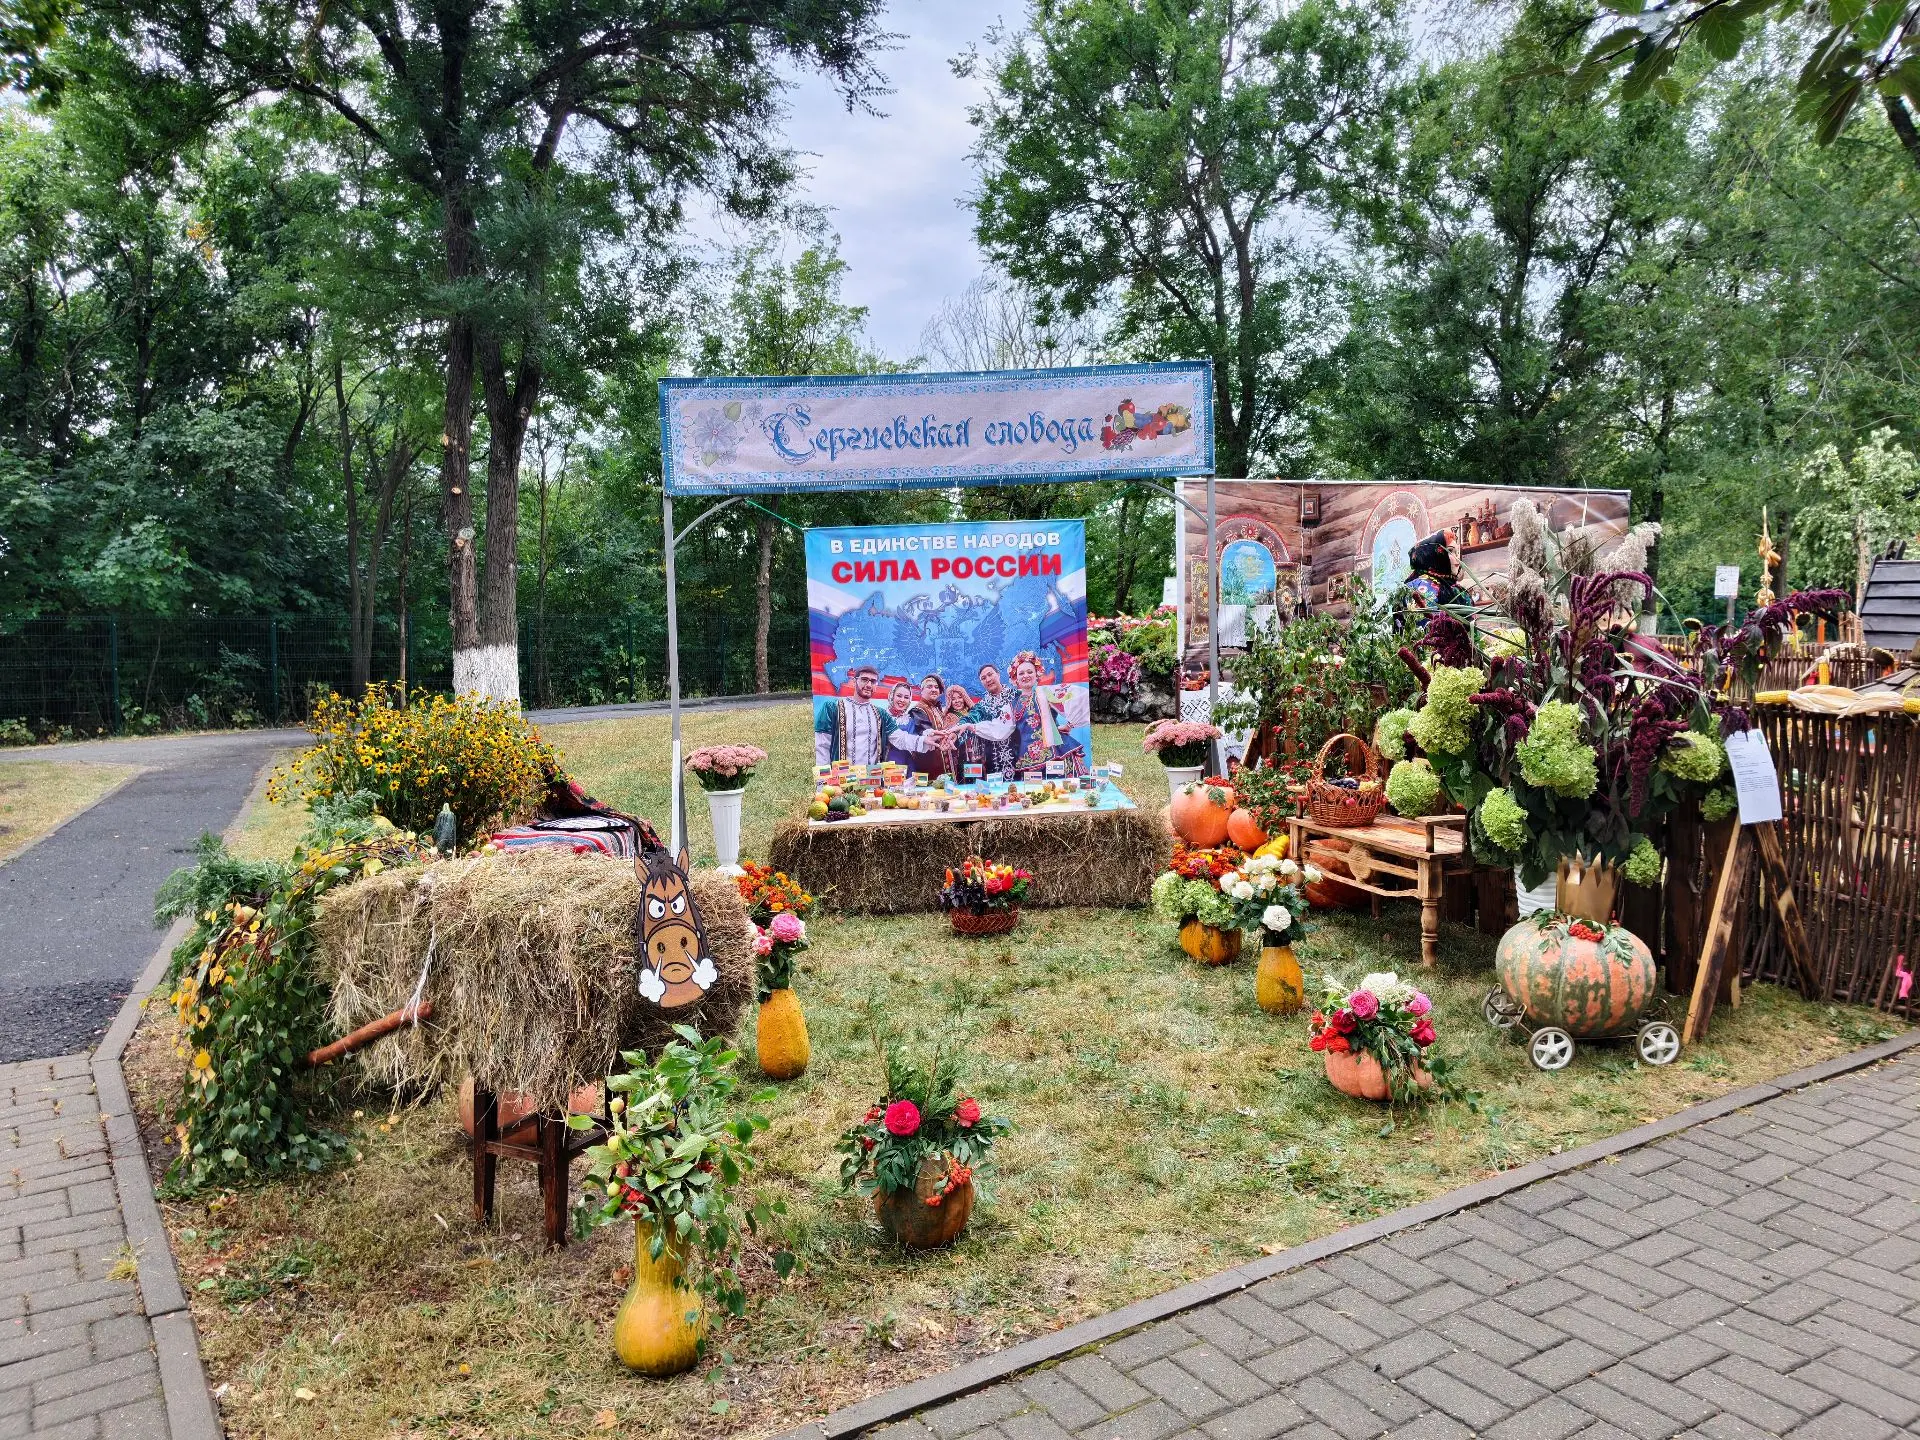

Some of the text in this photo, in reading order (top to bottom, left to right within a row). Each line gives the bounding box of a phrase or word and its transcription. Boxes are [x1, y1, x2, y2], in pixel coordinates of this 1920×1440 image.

[761, 402, 1095, 466] Сергиевская слобода
[831, 532, 1061, 555] В ЕДИНСТВЕ НАРОДОВ
[831, 553, 1062, 584] СИЛА РОССИИ
